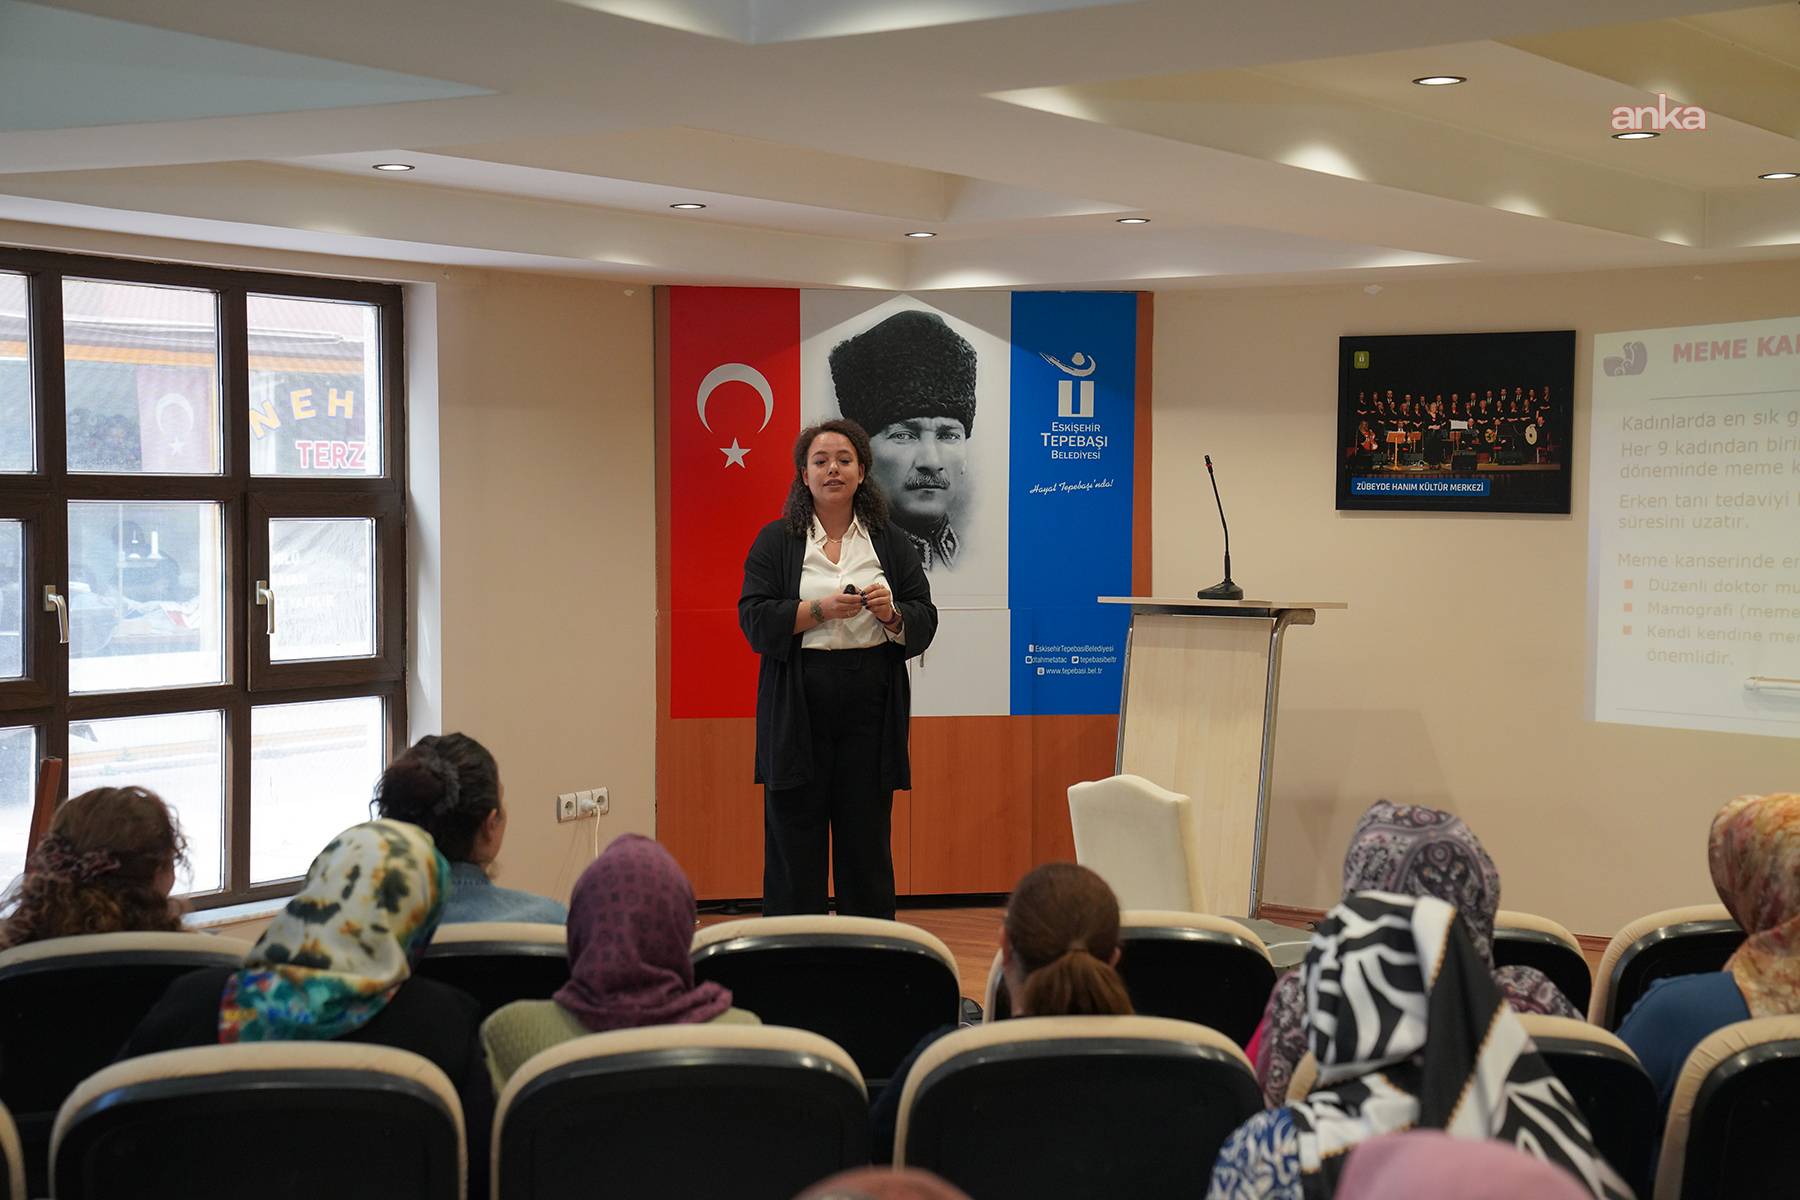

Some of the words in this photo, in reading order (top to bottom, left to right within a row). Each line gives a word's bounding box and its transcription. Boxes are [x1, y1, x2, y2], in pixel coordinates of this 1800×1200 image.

[1673, 338, 1747, 363] MEME
[1757, 334, 1800, 357] KA
[1051, 422, 1101, 434] ESKİŞEHİR
[1622, 413, 1716, 431] Kadınlarda
[1723, 413, 1745, 427] en
[1753, 409, 1779, 425] sık
[1040, 433, 1108, 450] TEPEBAŞI
[1621, 442, 1652, 457] Her
[1658, 441, 1668, 456] 9
[1675, 438, 1758, 455] kadından
[1767, 436, 1800, 452] biri
[295, 441, 365, 468] TERZ
[1051, 450, 1101, 460] BELEDİYESİ
[1620, 461, 1718, 478] döneminde
[1725, 462, 1783, 476] meme
[1356, 482, 1390, 491] ZÜBEYDE
[1392, 483, 1418, 491] HANIM
[1419, 482, 1448, 491] KÜLTÜR
[1449, 482, 1484, 492] MERKEZİ
[1619, 494, 1668, 508] Erken
[1675, 494, 1708, 508] tanı
[1715, 491, 1789, 510] tedaviyi
[1618, 514, 1685, 529] süresini
[1692, 515, 1749, 529] uzatır.
[1617, 553, 1668, 568] Meme
[1675, 553, 1775, 569] kanserinde
[1648, 578, 1708, 592] Düzenli
[1713, 579, 1769, 593] doktor
[1648, 602, 1733, 619] Mamografi
[1740, 603, 1800, 620] (meme
[1647, 625, 1691, 639] Kendi
[1697, 626, 1762, 642] kendine
[1769, 631, 1800, 643] me
[1647, 648, 1734, 665] önemlidir.
